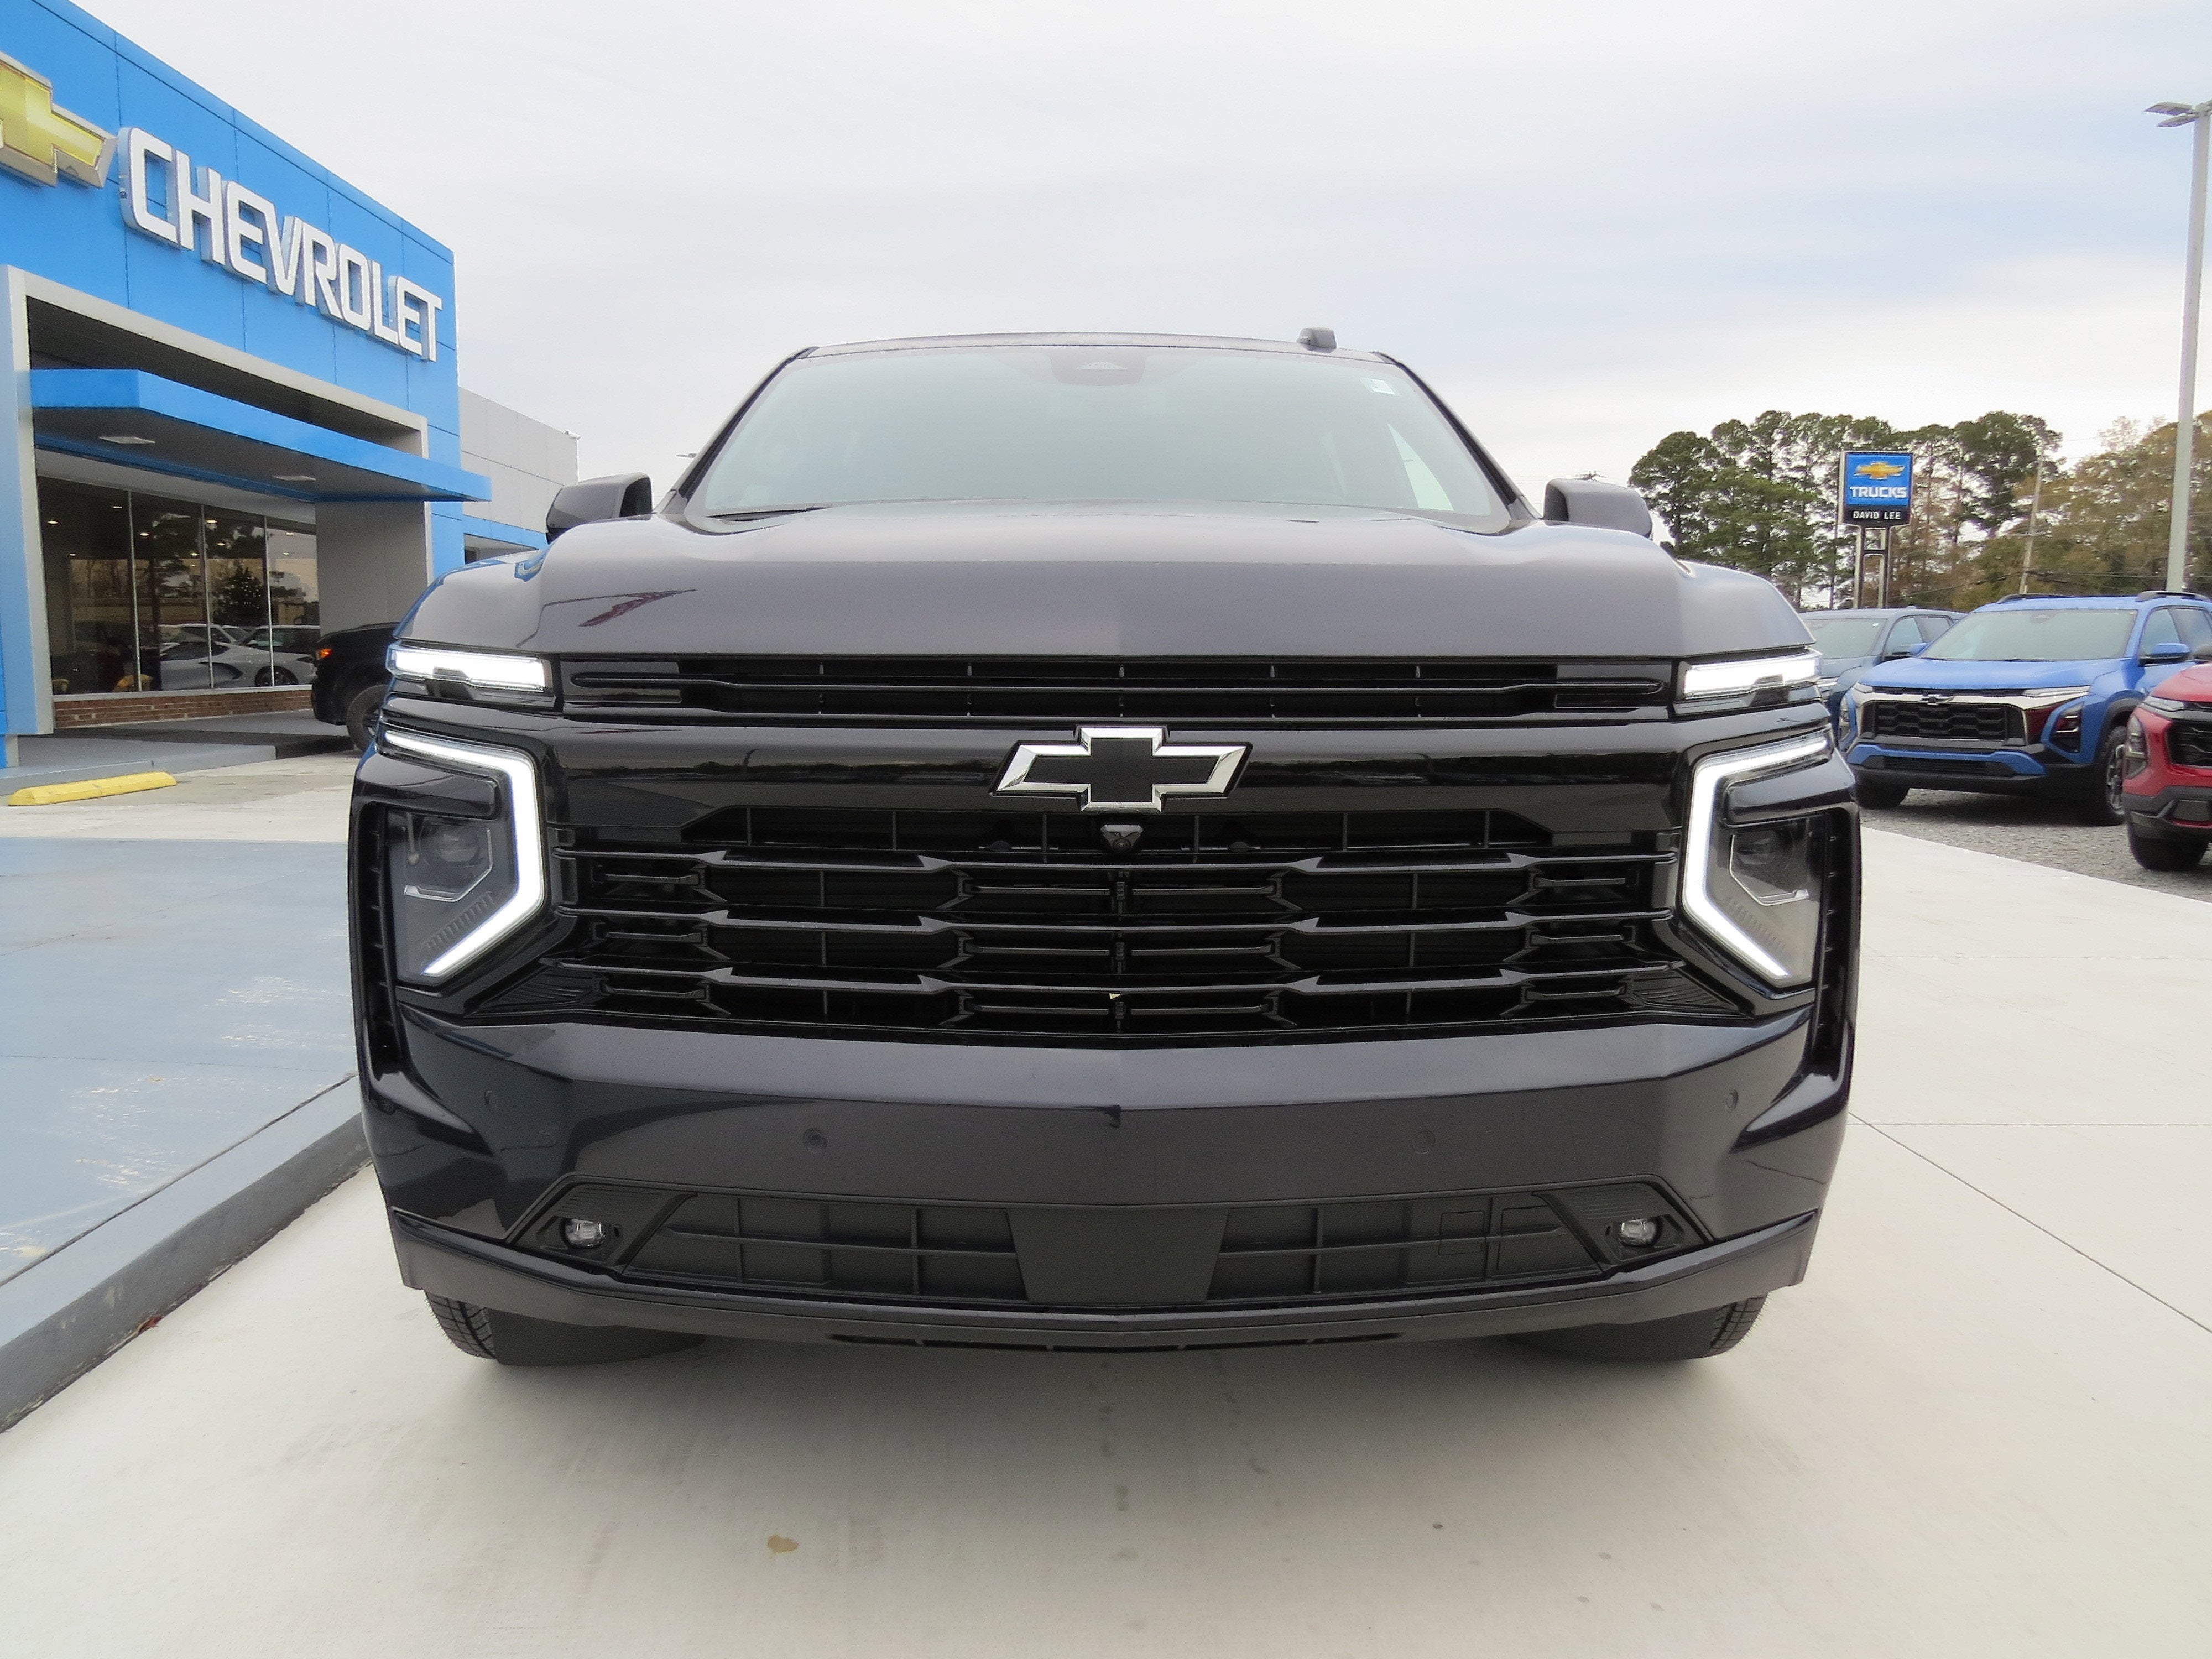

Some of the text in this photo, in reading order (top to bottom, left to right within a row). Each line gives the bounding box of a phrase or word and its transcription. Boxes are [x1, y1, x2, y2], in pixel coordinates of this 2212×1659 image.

[118, 127, 442, 362] CHEVROLET
[1850, 486, 1907, 498] TRUCKS
[1853, 510, 1901, 519] DAVID LEE
